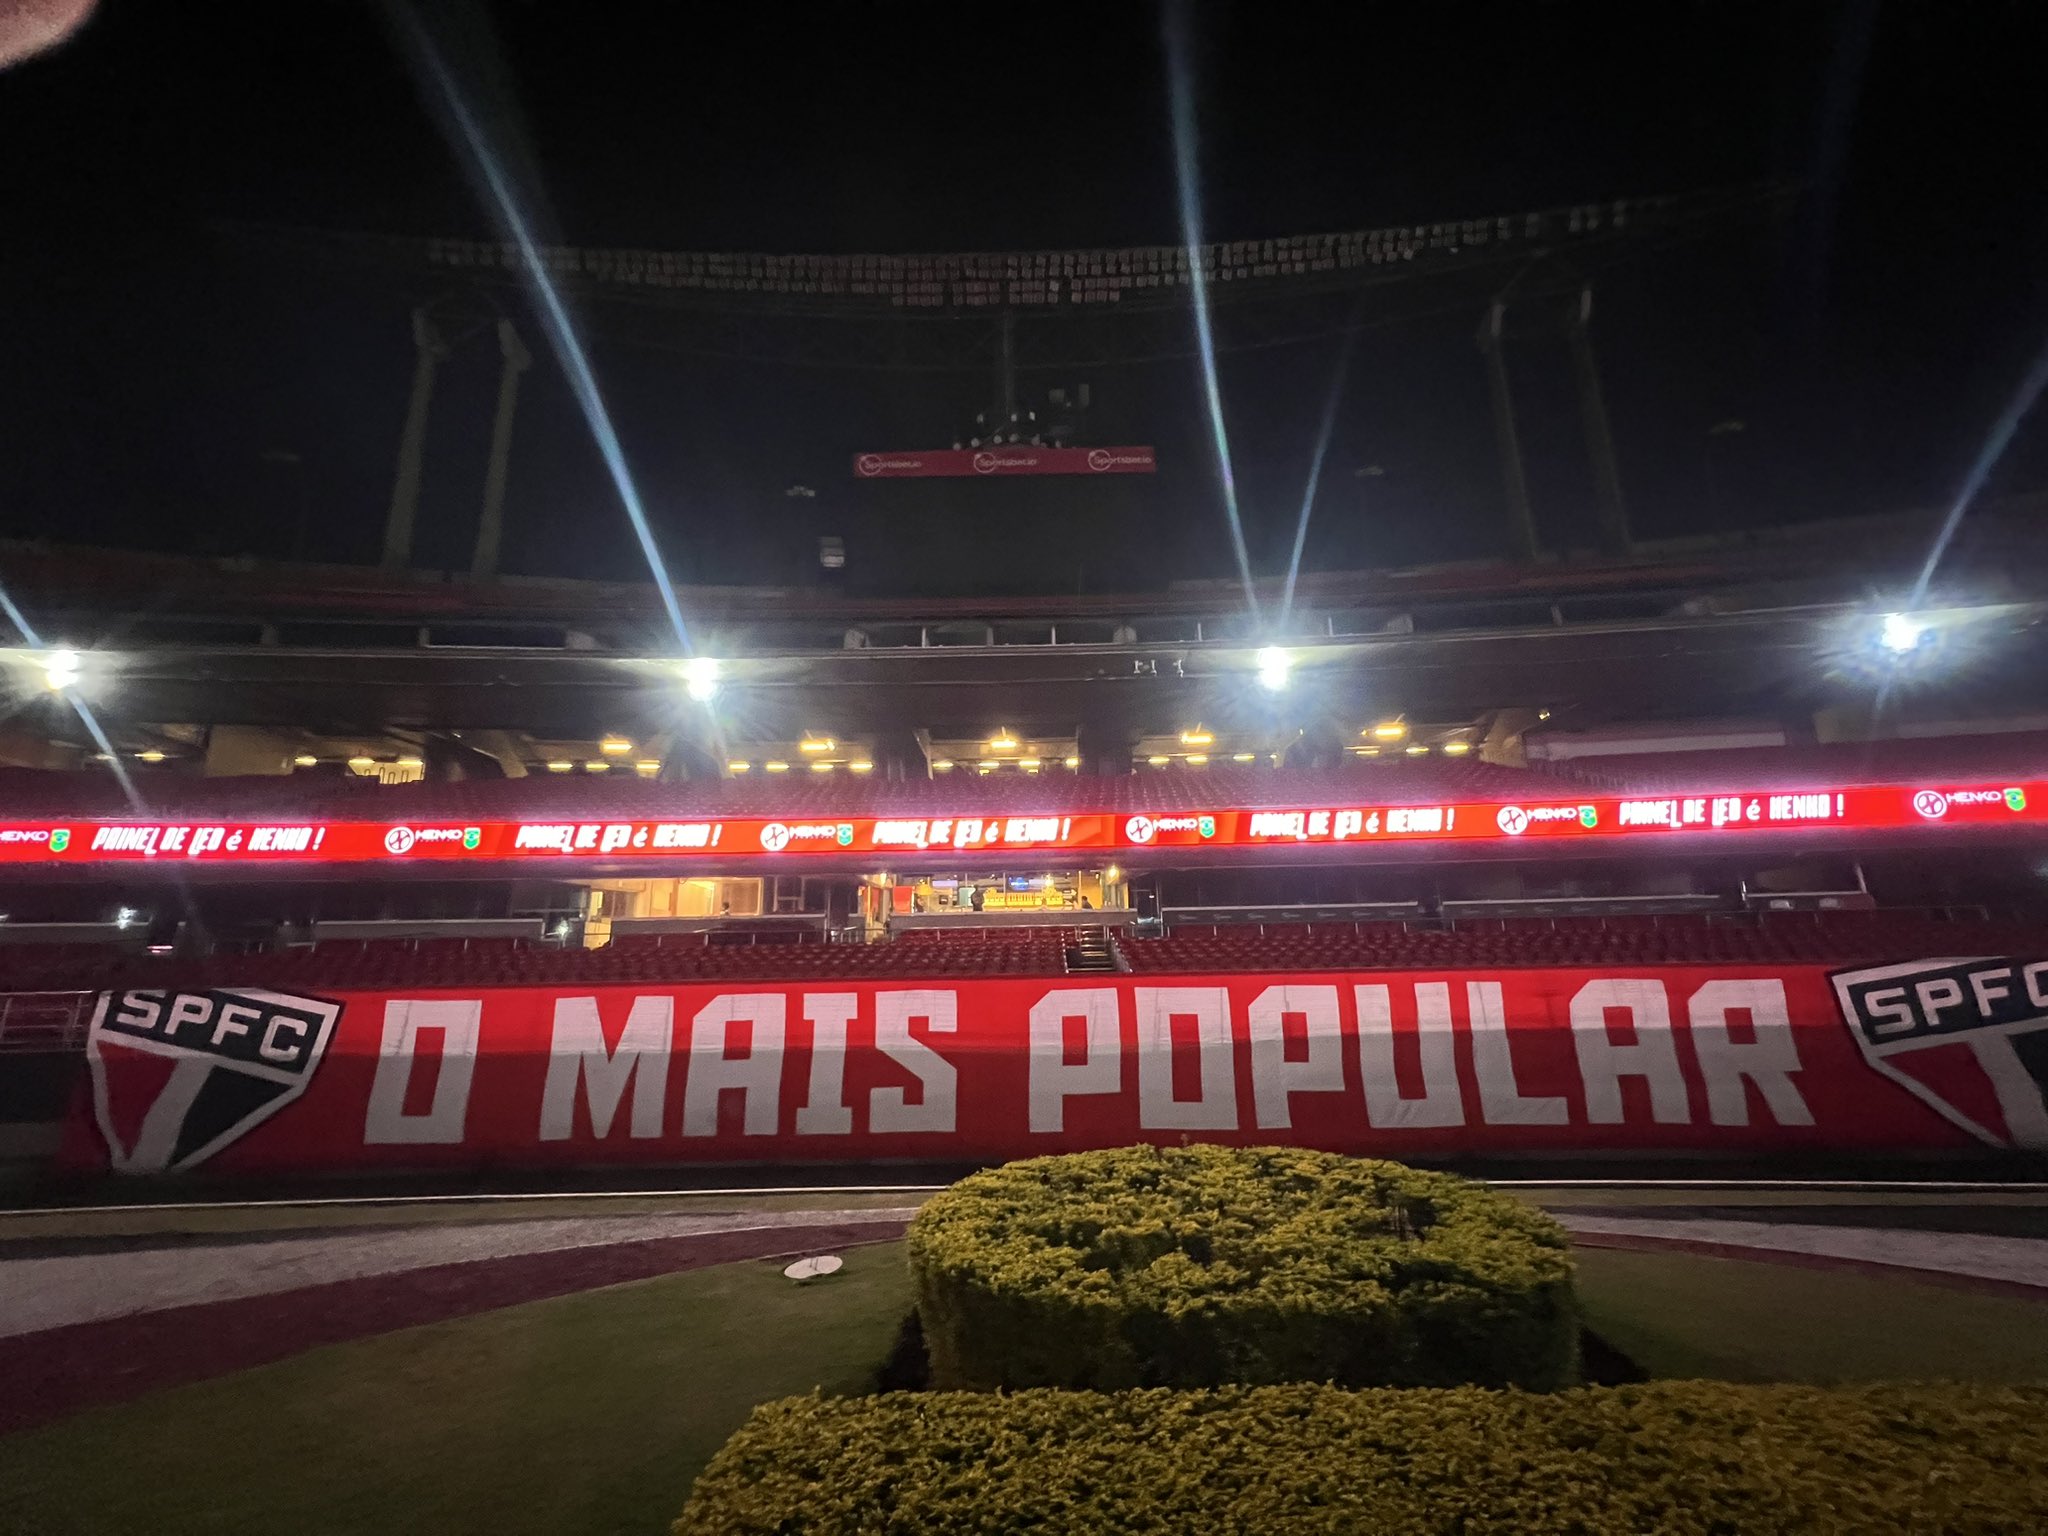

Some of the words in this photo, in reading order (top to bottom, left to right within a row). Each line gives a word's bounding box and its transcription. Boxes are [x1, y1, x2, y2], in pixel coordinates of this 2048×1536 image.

[160, 827, 191, 850] DE
[116, 990, 308, 1061] SPFC
[364, 1000, 482, 1144] O
[539, 990, 957, 1141] MAIS
[1028, 978, 1815, 1134] POPULAR
